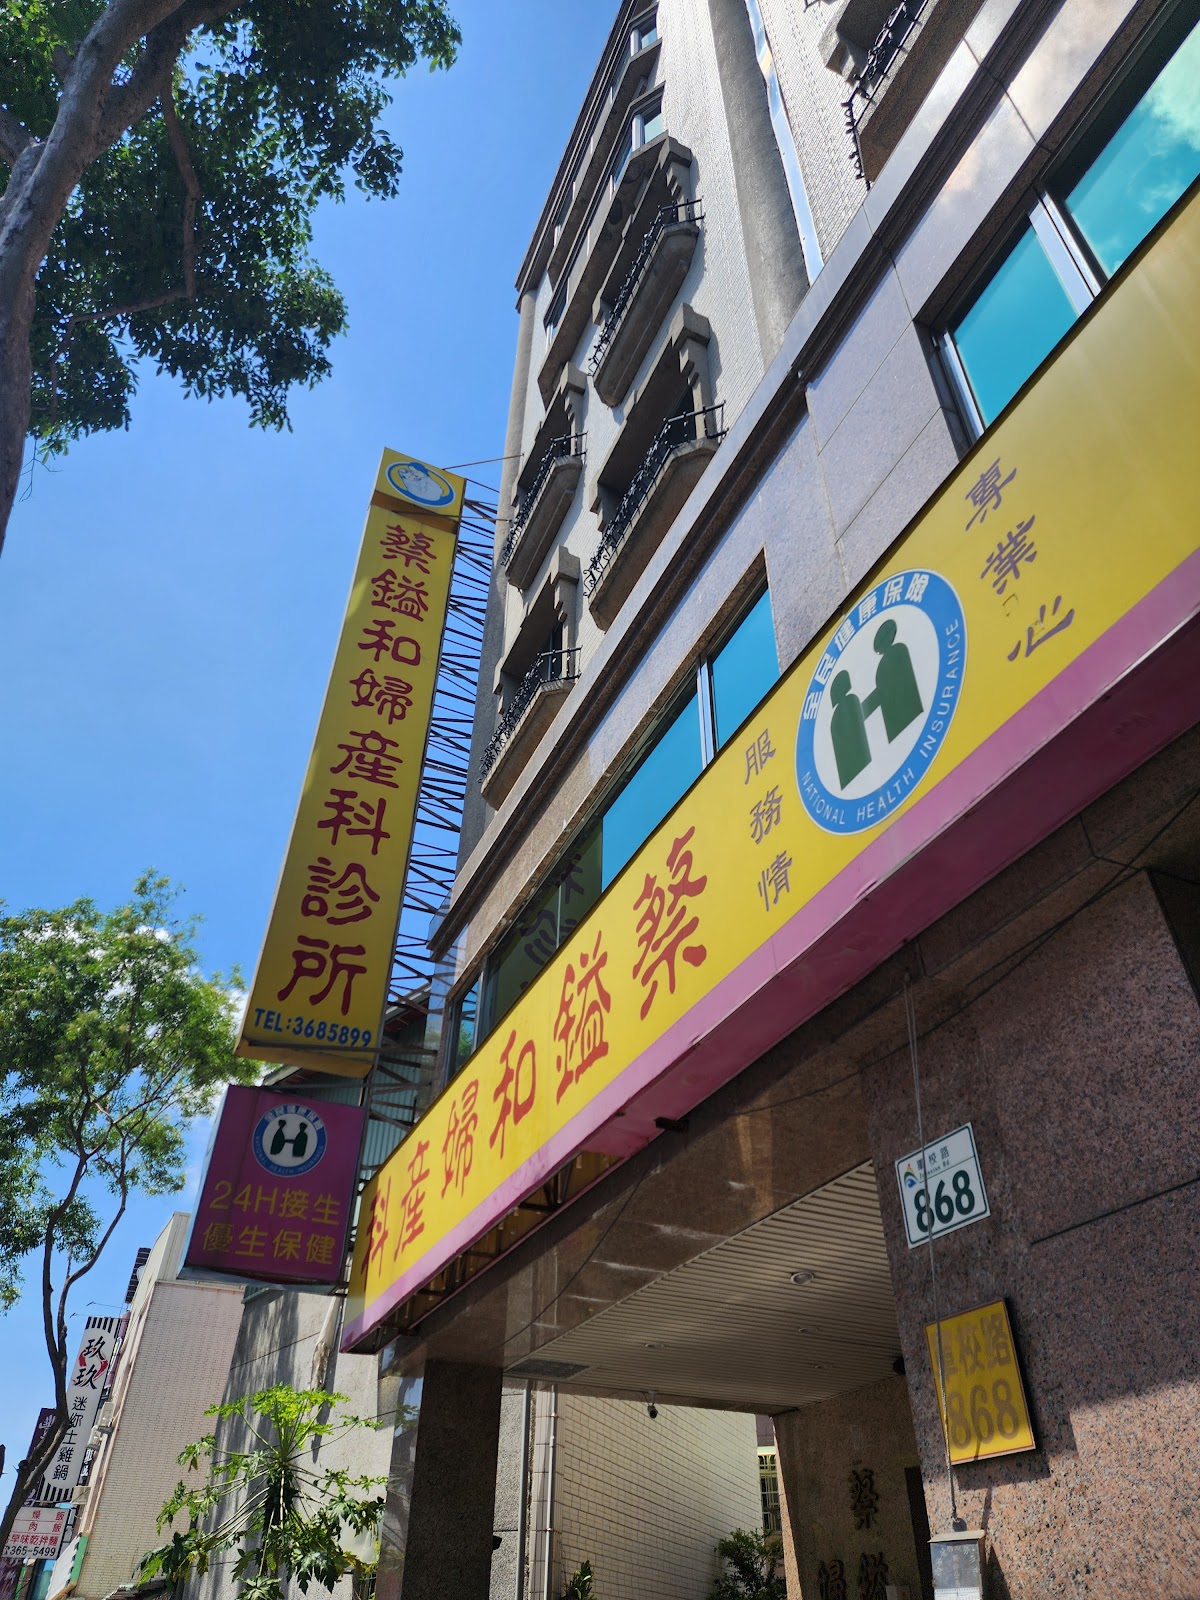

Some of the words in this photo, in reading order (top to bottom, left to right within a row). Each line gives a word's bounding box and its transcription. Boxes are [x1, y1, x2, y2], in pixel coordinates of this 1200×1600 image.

[803, 573, 929, 720] 全民健康保險
[801, 771, 846, 825] NATIONAL
[856, 768, 915, 823] HEALTH
[919, 618, 960, 759] INSURANCE
[254, 1007, 372, 1048] TEL:3685899
[209, 1179, 341, 1226] 24H接生
[914, 1170, 975, 1233] 868
[202, 1222, 336, 1265] 優生保健
[73, 1336, 106, 1390] 玖玖
[52, 1396, 88, 1481] 迷你土雞鍋
[948, 1378, 1020, 1450] 868
